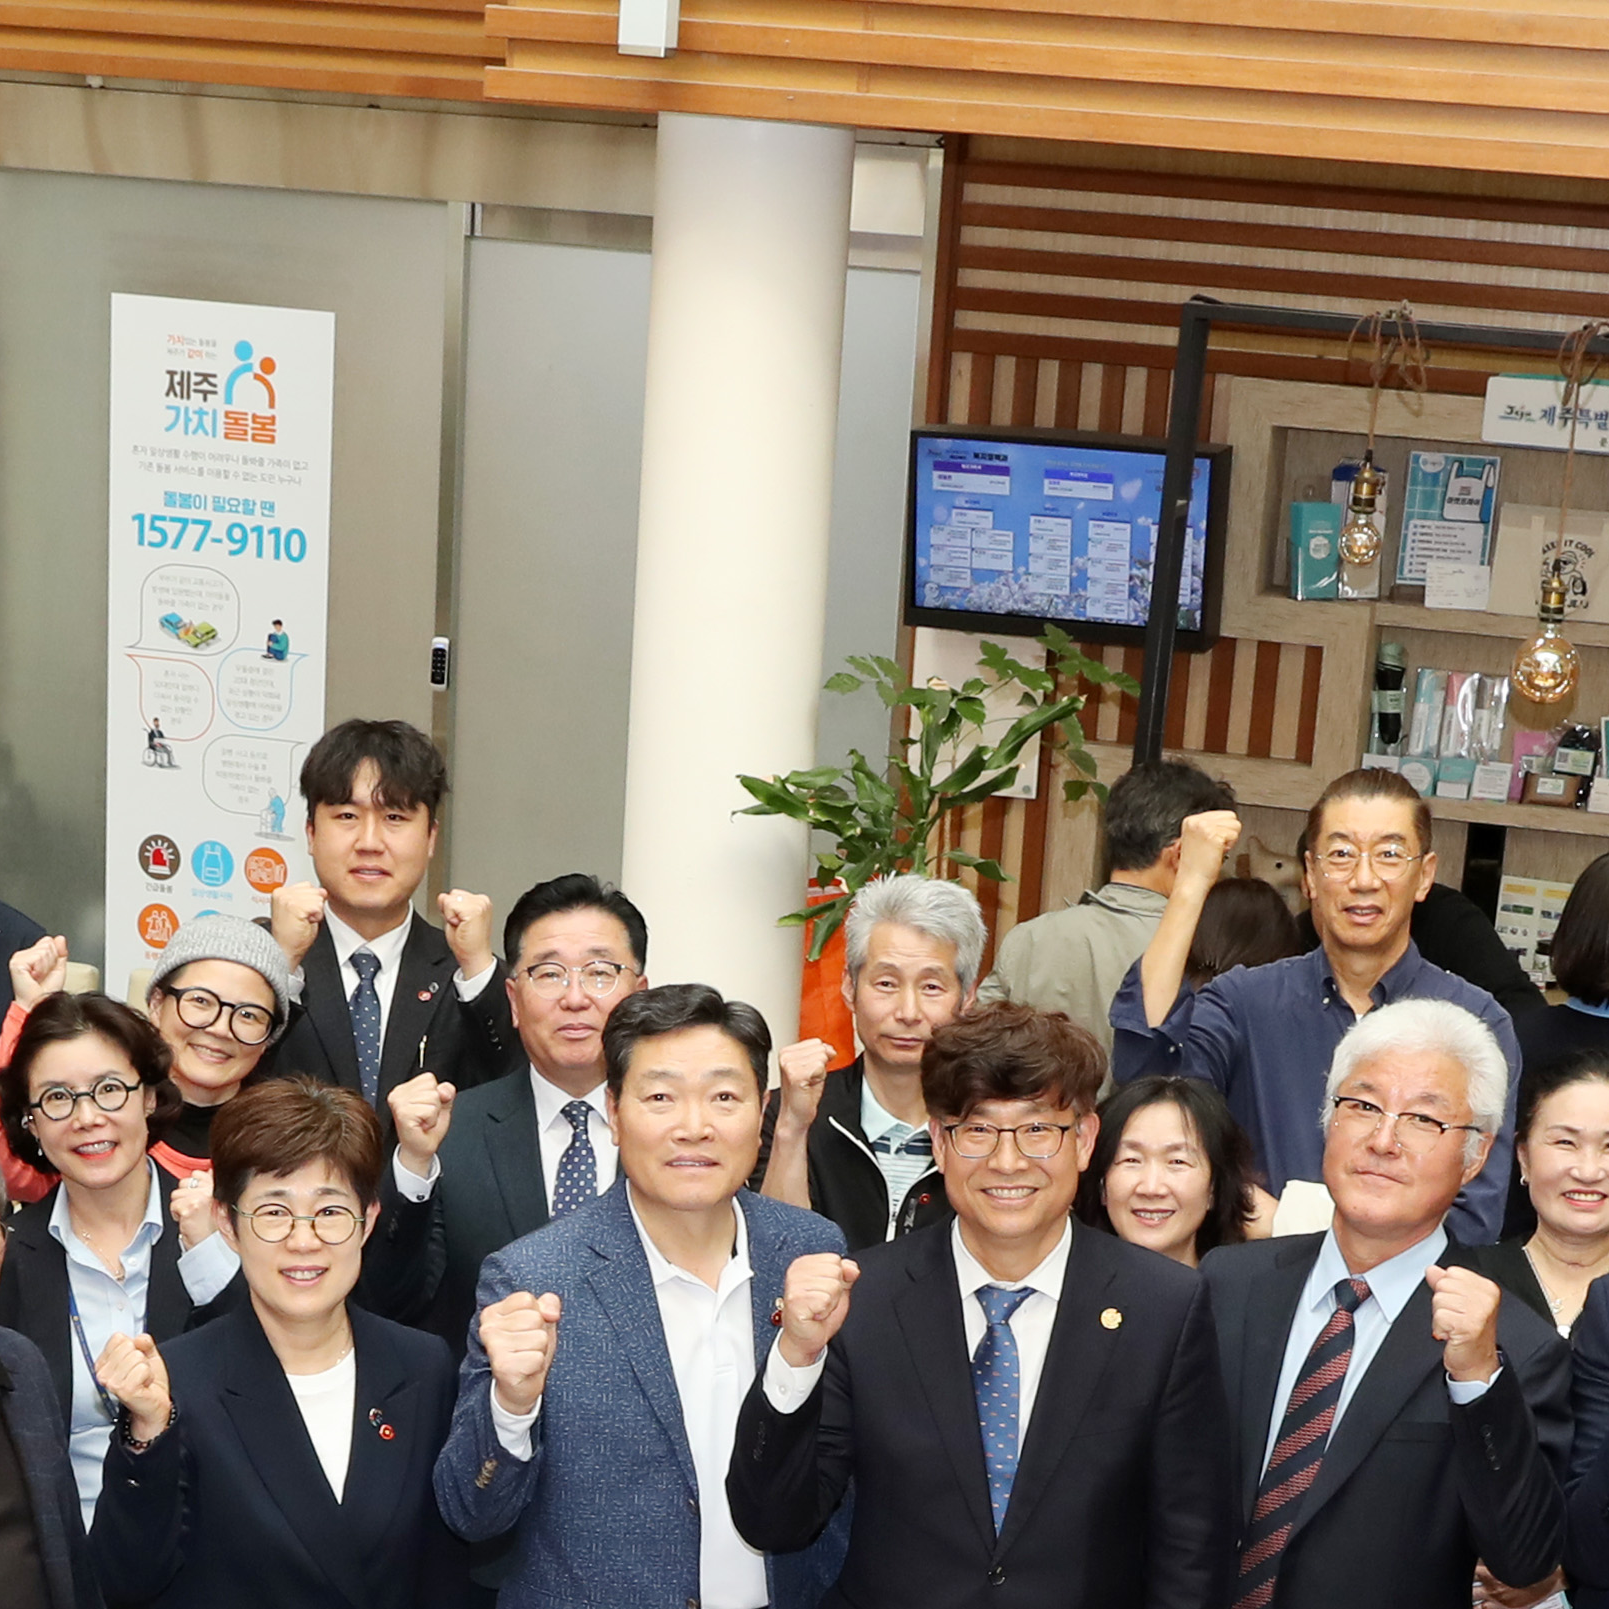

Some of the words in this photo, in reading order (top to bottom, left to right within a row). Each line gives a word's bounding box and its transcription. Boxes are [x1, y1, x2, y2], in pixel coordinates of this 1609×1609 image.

[164, 369, 219, 403] 제주
[164, 405, 218, 438] 가치
[223, 410, 277, 445] 돌봄
[163, 490, 208, 512] 돌봄이
[211, 495, 258, 517] 필요할
[131, 512, 307, 563] 1577-9110
